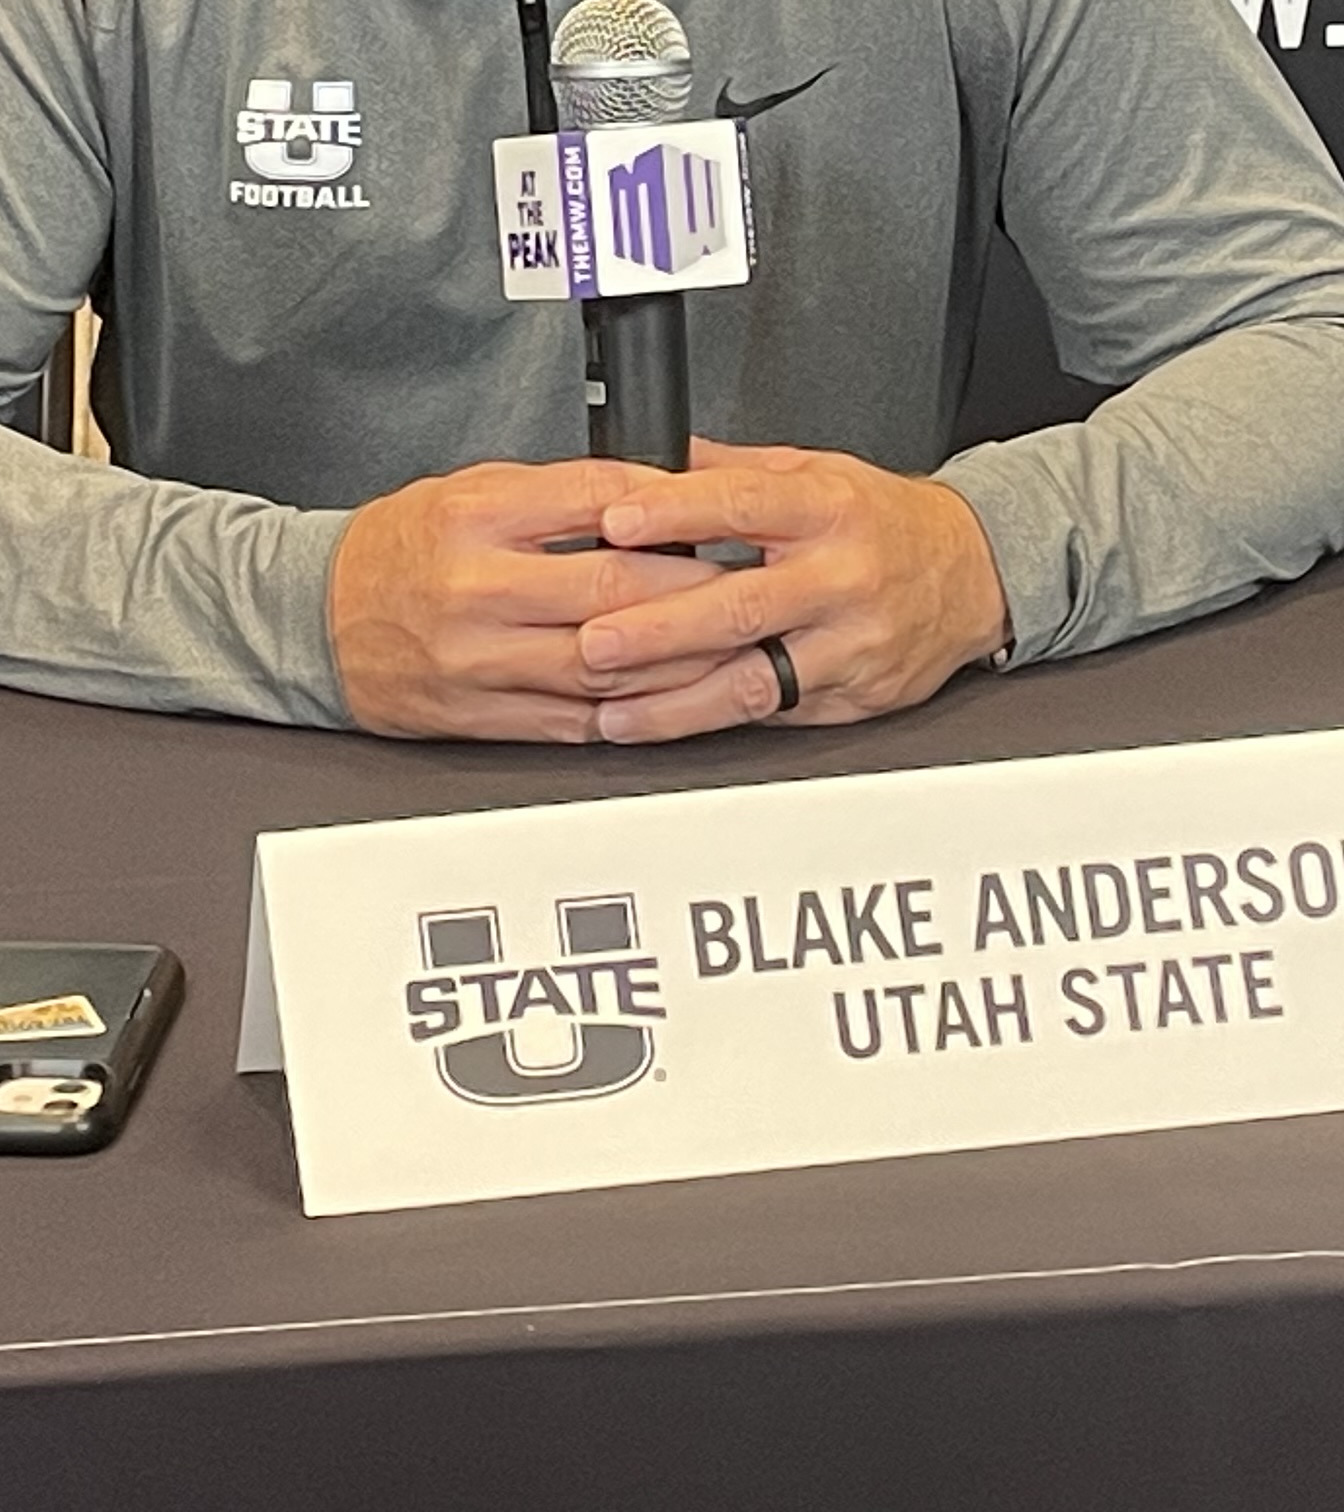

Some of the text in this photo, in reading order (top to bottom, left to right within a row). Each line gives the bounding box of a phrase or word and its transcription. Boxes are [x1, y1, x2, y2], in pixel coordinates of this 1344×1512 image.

[236, 110, 363, 146] STATE
[230, 180, 371, 210] FOOTBALL
[520, 171, 536, 197] AT
[517, 200, 544, 228] THE
[563, 145, 592, 285] THEMW.COM
[508, 229, 560, 271] PEAK
[689, 879, 942, 979] BLAKE
[405, 955, 667, 1043] STATE
[833, 949, 1284, 1060] UTAH STATE
